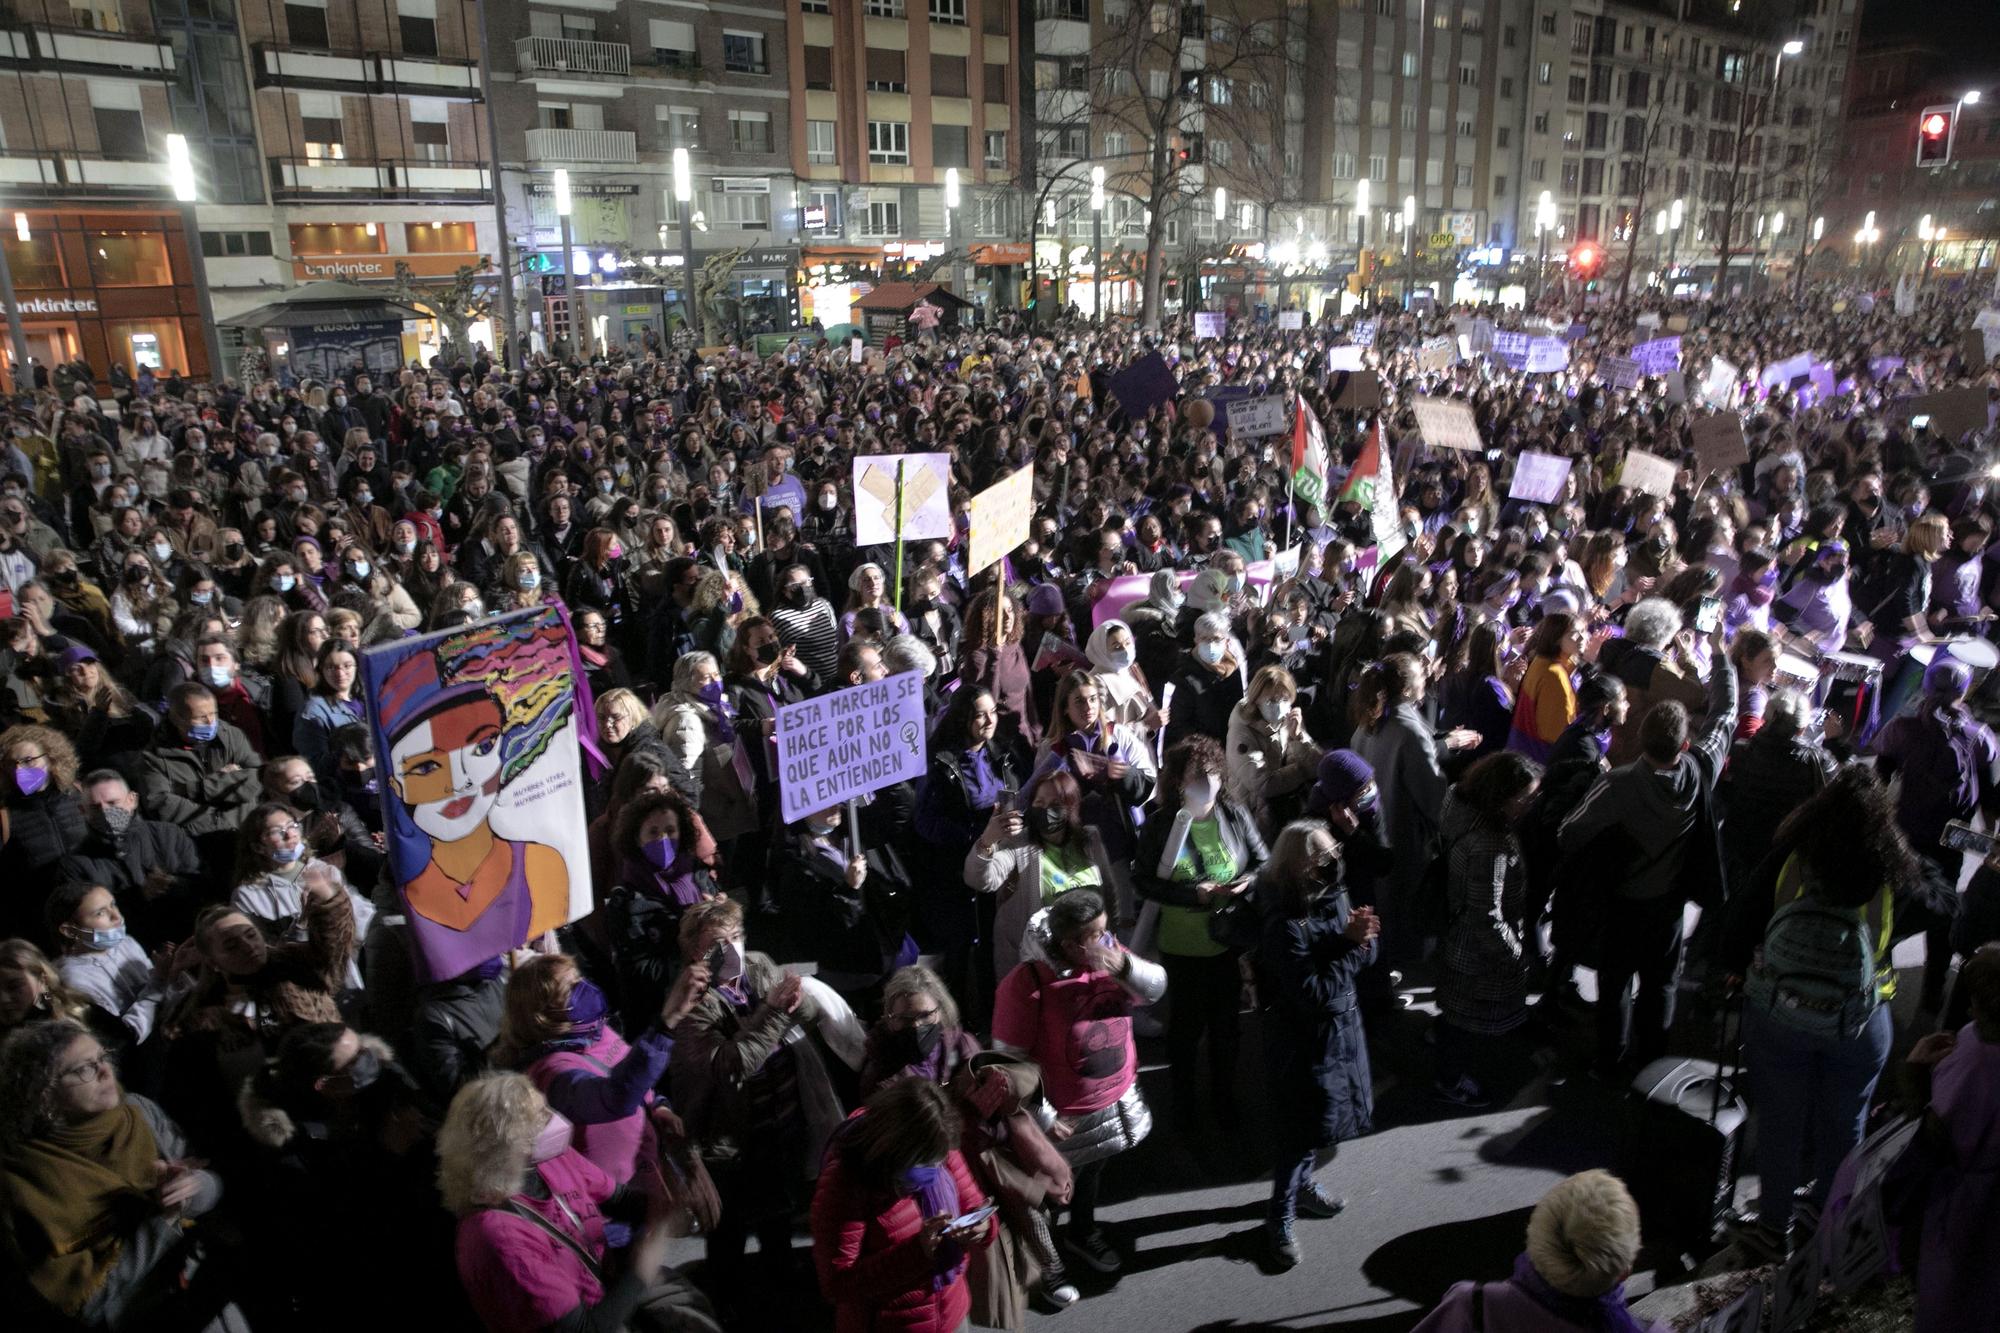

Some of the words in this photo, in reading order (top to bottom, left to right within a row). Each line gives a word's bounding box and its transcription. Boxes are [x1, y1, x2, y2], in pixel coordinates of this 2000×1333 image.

[762, 254, 788, 263] PARK
[1430, 233, 1455, 245] ORO
[783, 703, 822, 732] ESTA
[830, 684, 889, 718] MARCHA
[897, 676, 917, 699] SE
[787, 725, 829, 758] HACE
[837, 715, 866, 741] POR
[873, 704, 900, 730] LOS
[787, 754, 820, 784] QUE
[827, 739, 862, 771] AÚN
[869, 730, 892, 756] NO
[789, 787, 811, 812] LA
